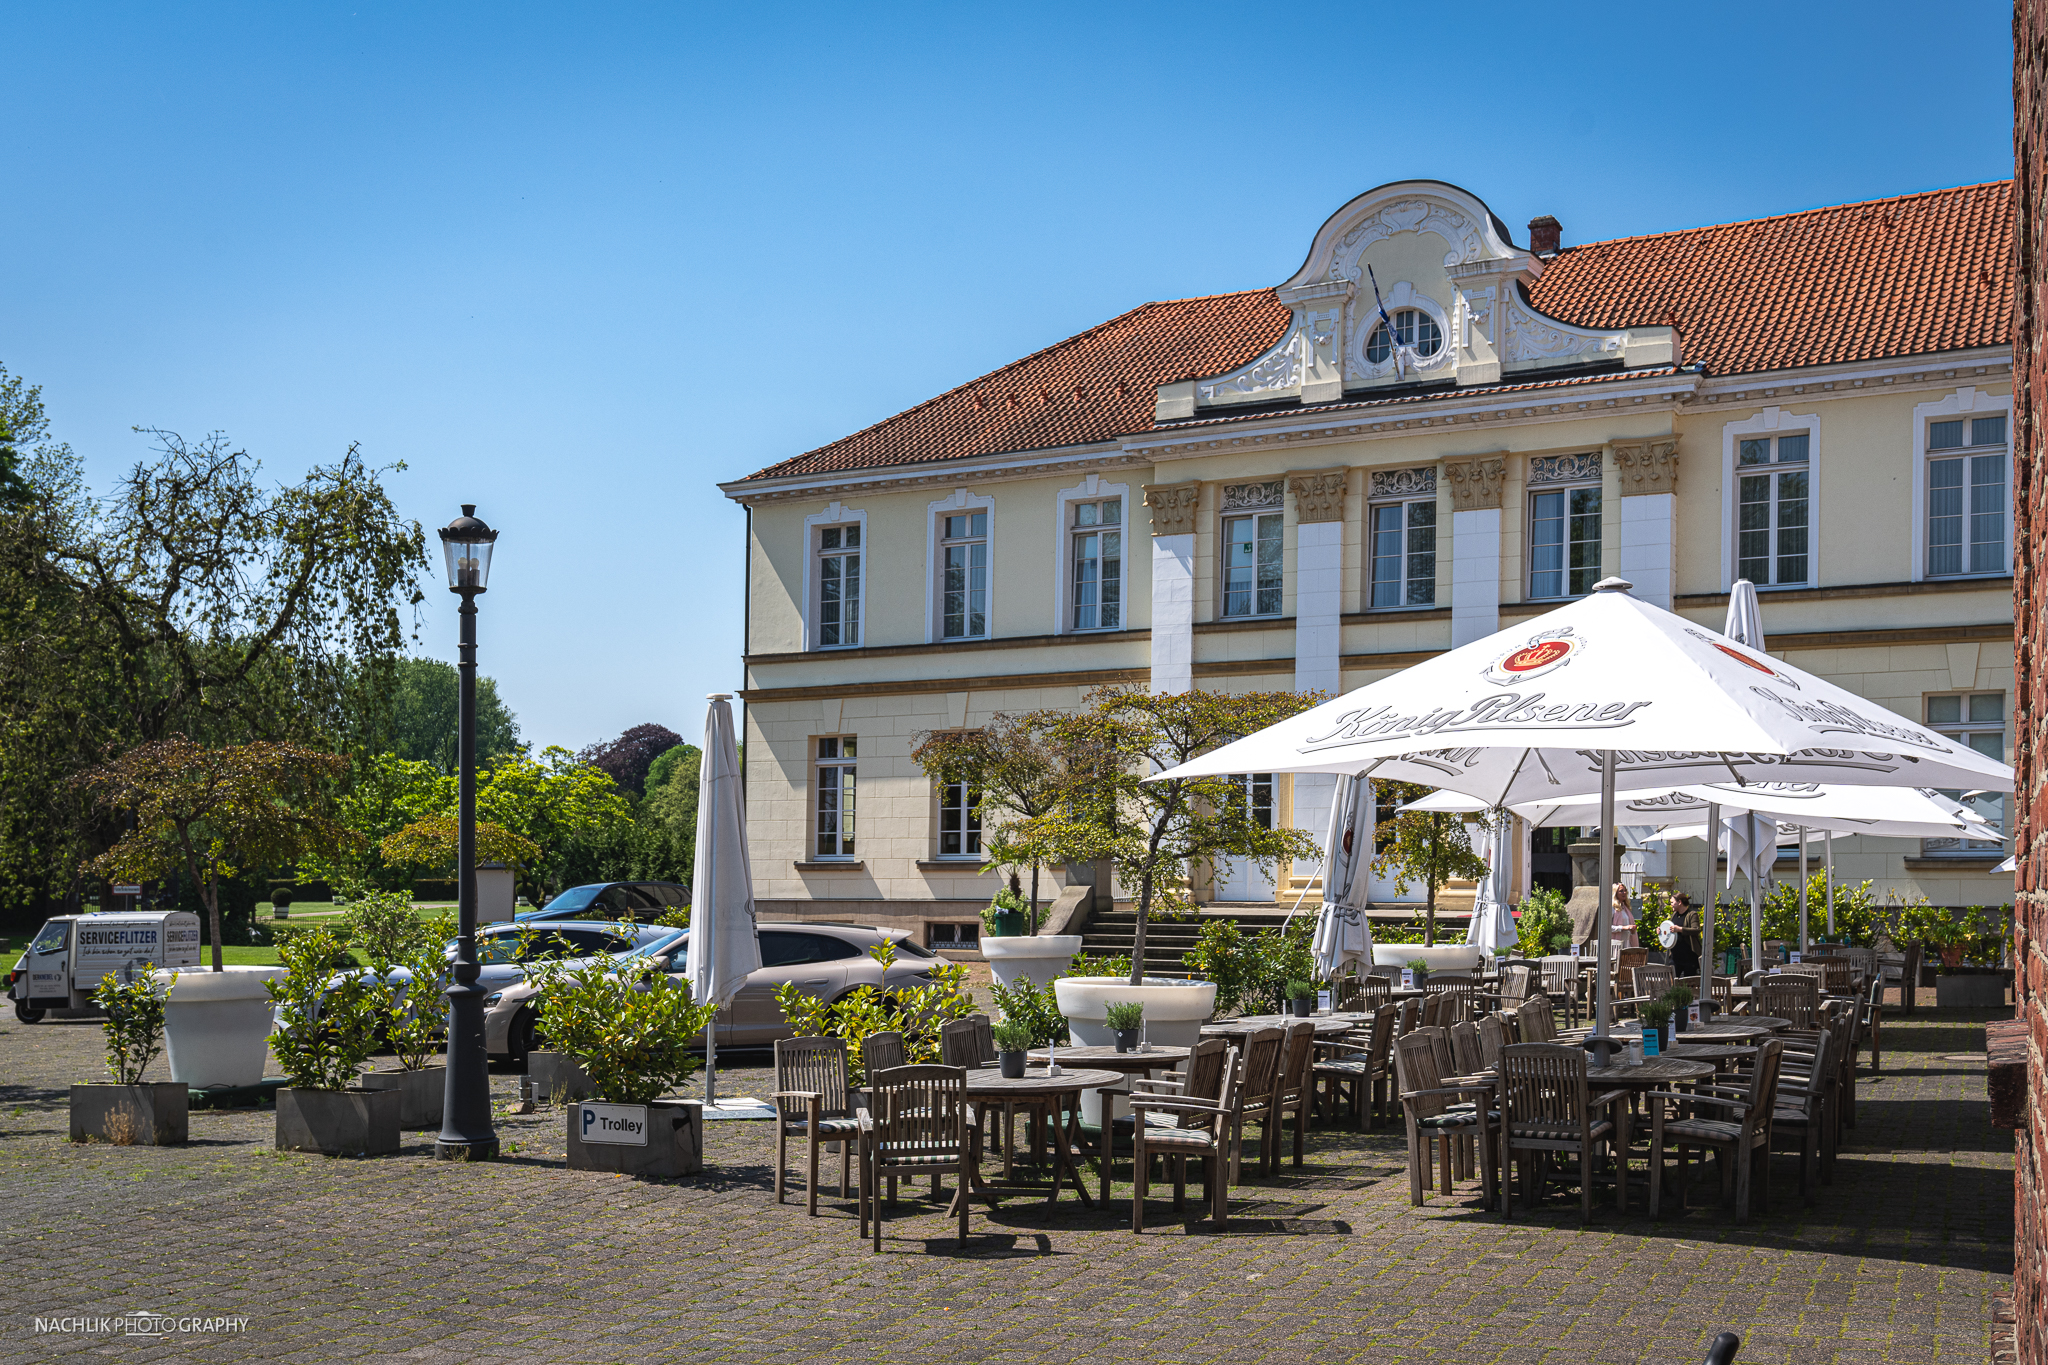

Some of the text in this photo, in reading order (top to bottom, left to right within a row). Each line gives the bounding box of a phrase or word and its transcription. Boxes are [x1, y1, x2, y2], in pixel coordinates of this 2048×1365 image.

[1306, 692, 1652, 743] König Pilsener
[80, 930, 157, 944] SERVICEFLITZER
[583, 1109, 643, 1135] P Trolley
